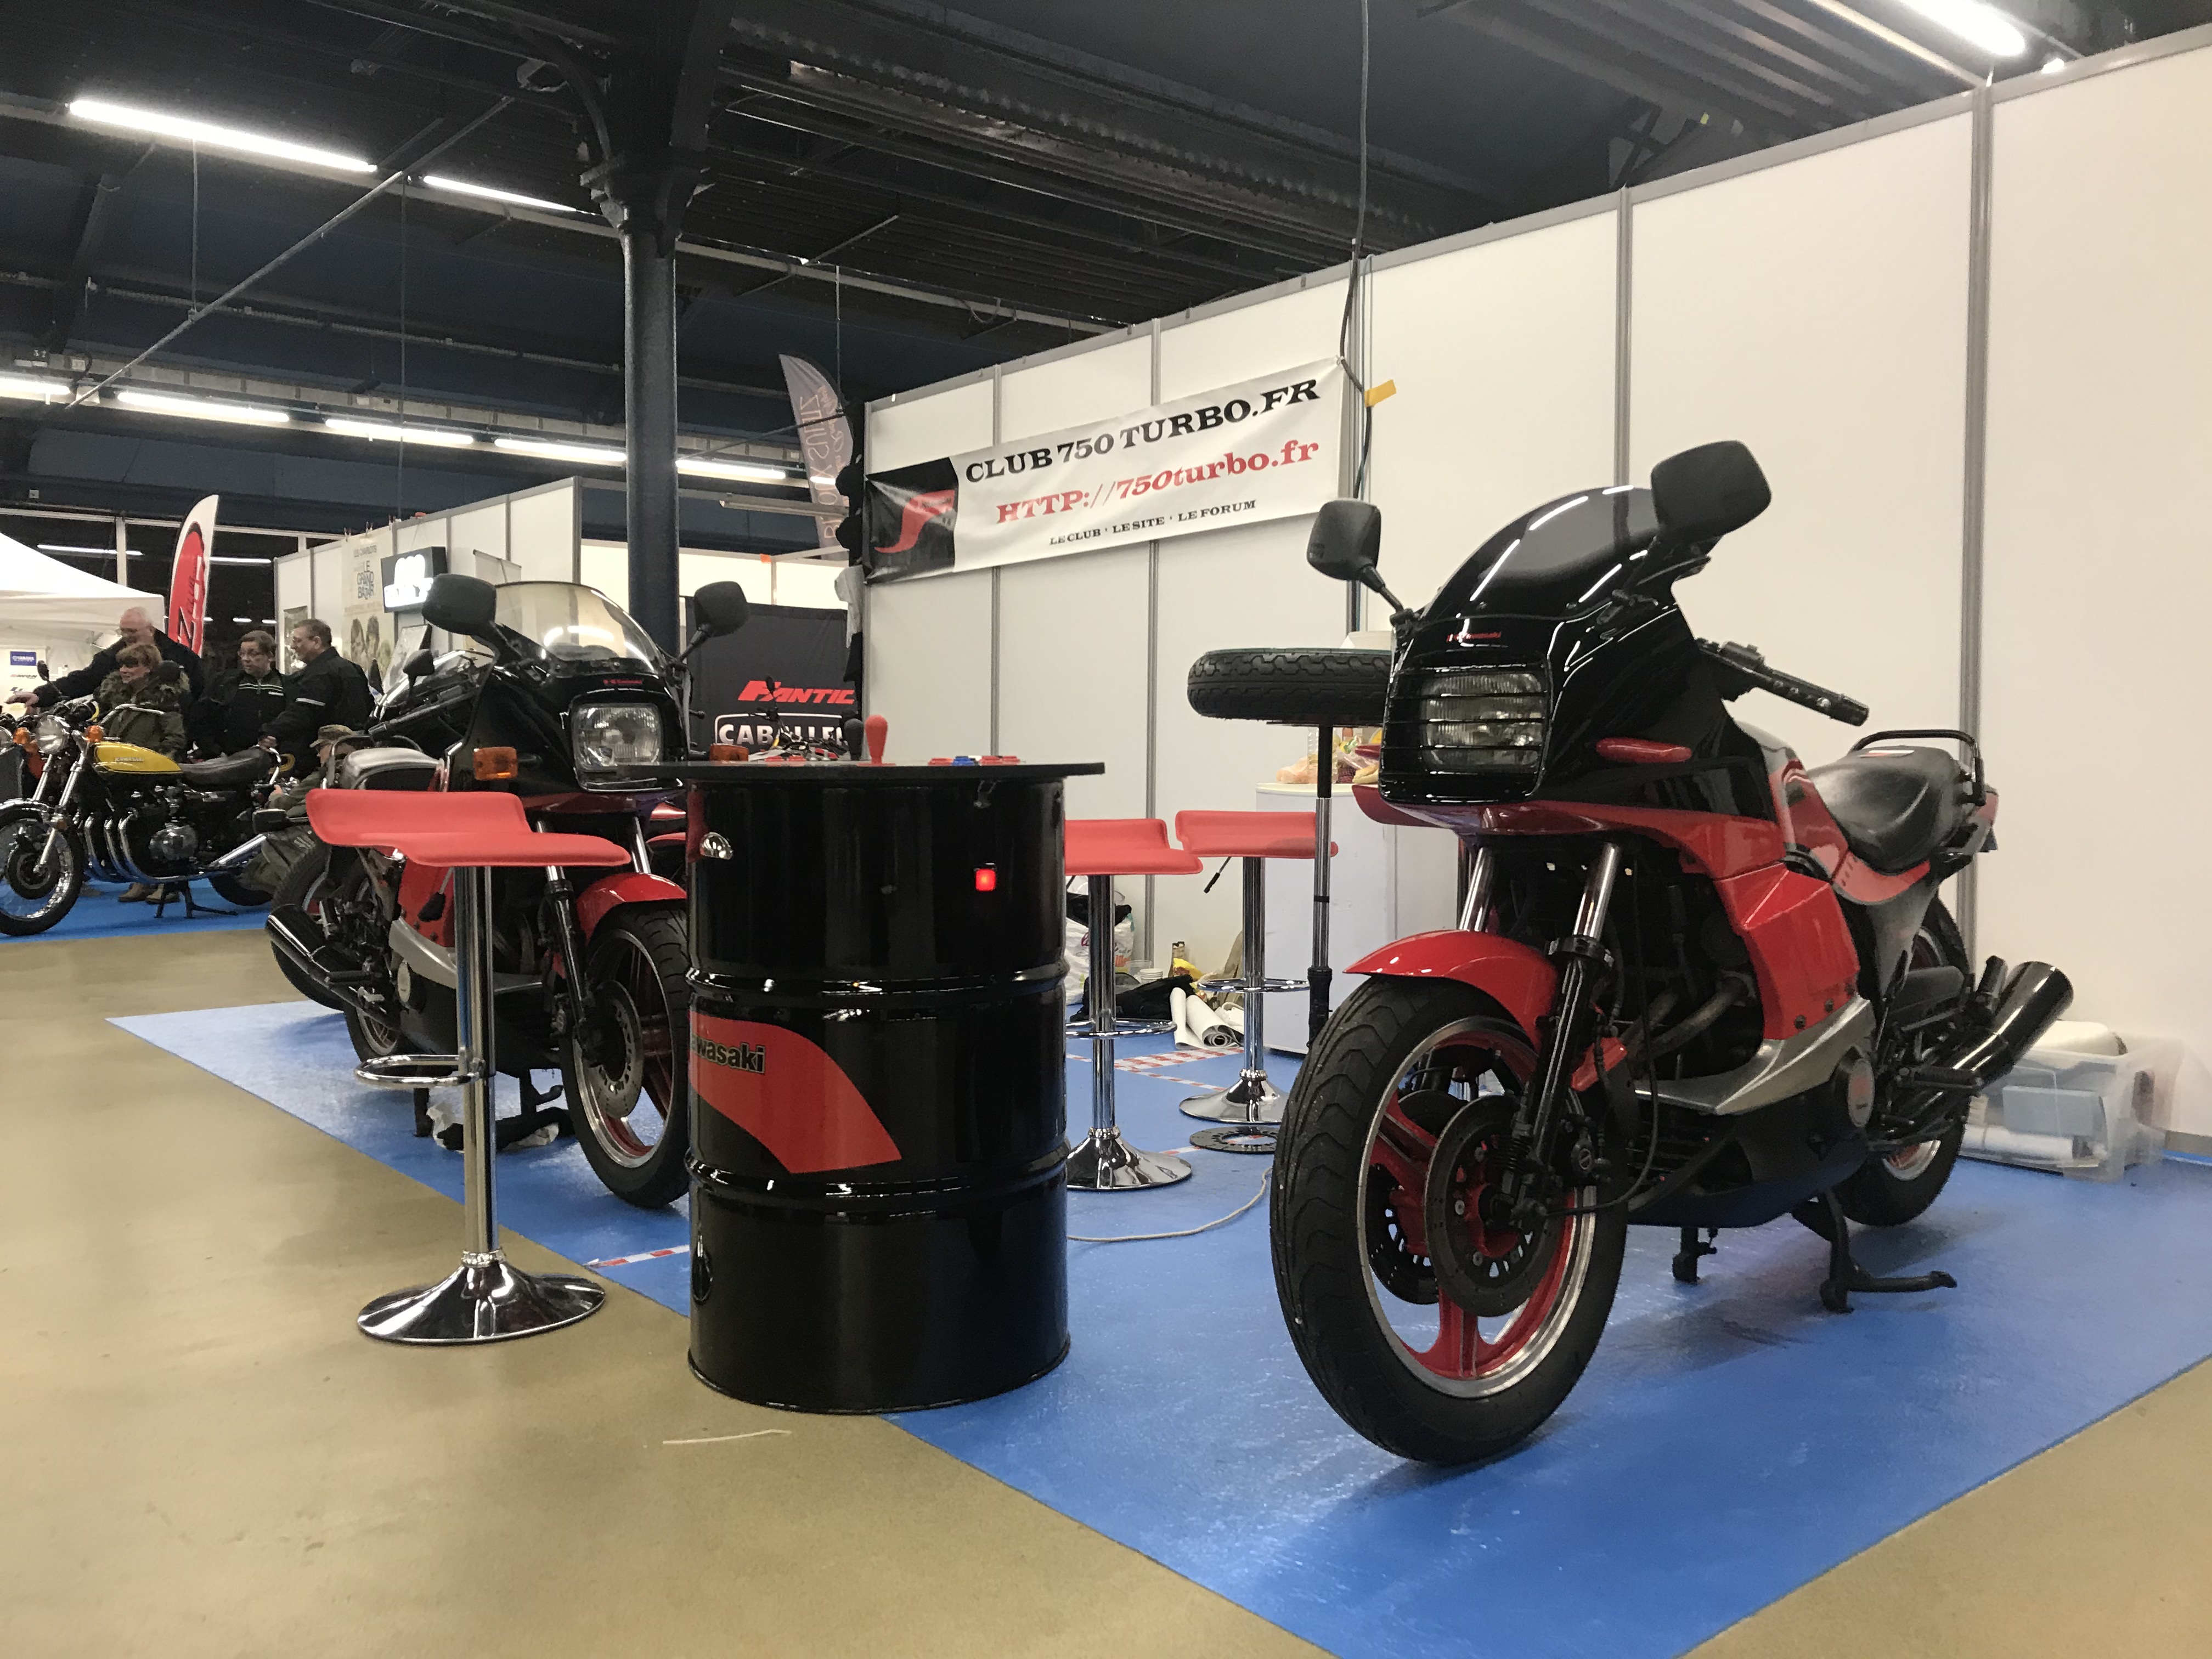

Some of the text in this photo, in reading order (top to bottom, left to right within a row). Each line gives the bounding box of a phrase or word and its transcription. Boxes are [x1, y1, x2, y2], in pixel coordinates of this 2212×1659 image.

[966, 379, 1321, 483] CLUB 750 TURBO.FR
[1049, 499, 1257, 545] LE CLUB LE SITE LE FORUM
[738, 680, 855, 704] FANTIC
